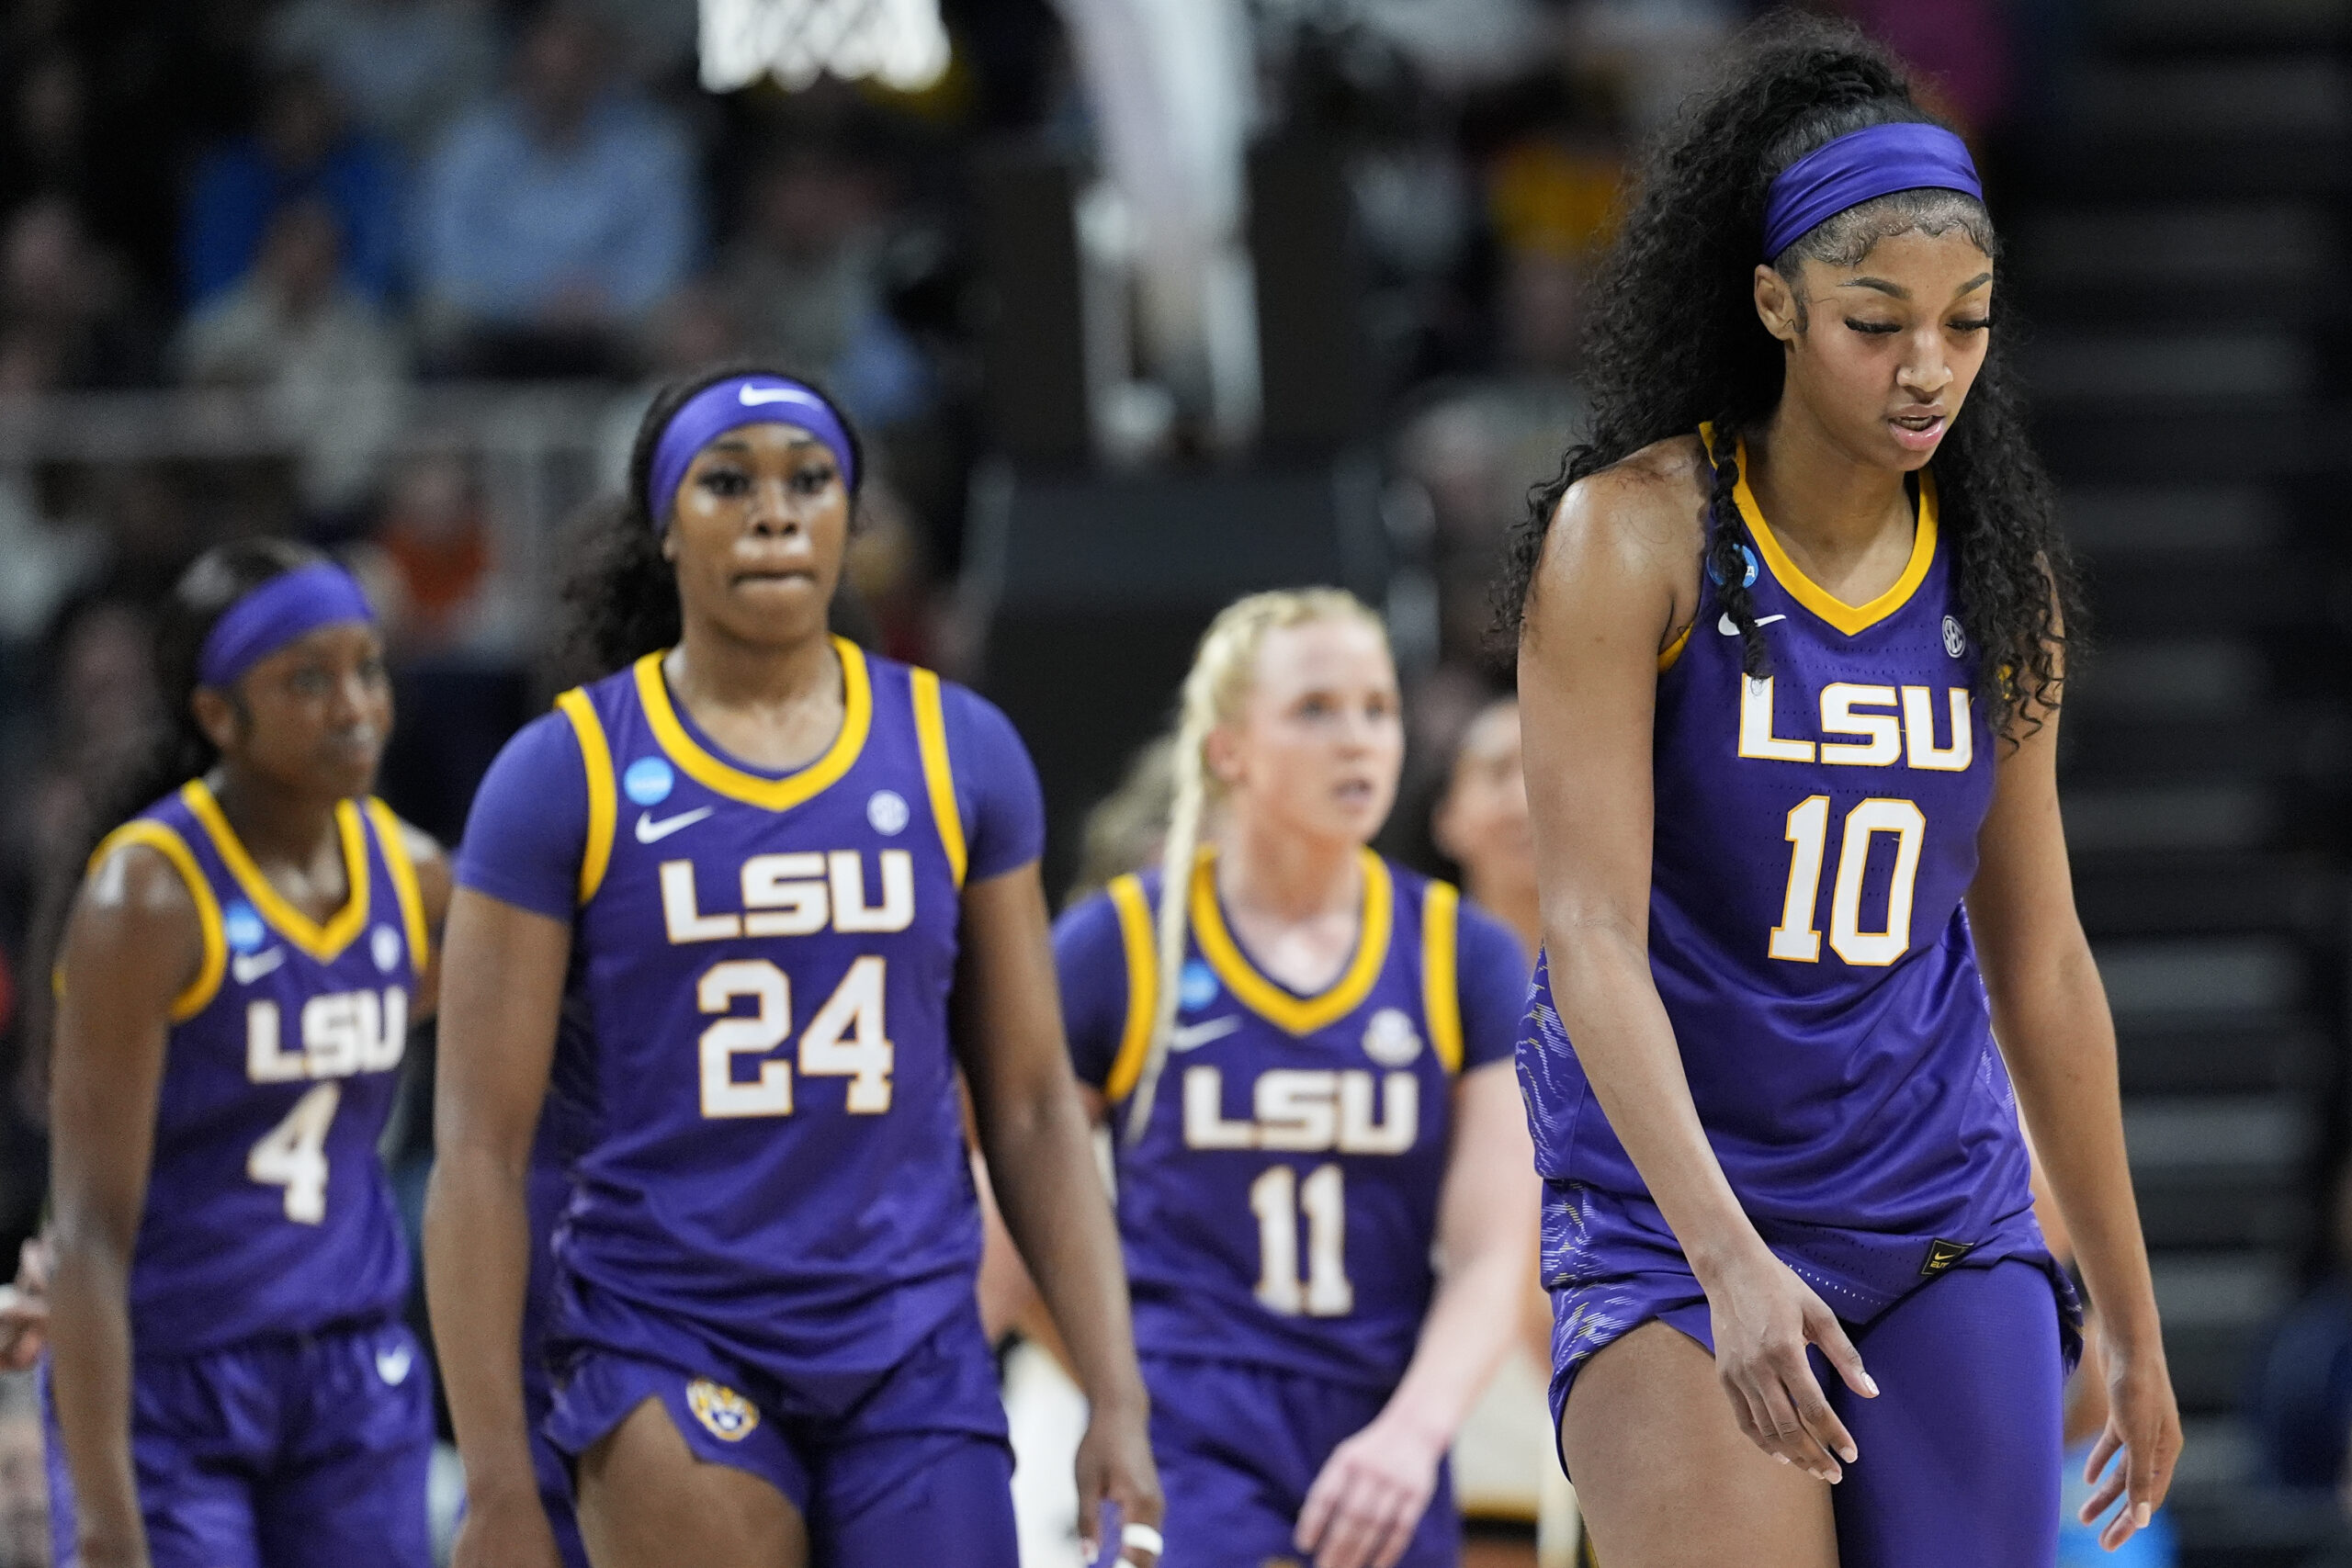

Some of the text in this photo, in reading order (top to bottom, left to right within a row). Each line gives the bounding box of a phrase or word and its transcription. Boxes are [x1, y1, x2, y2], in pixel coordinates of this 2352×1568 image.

[1738, 673, 1973, 772] LSU
[659, 849, 916, 945] LSU
[1768, 795, 1927, 966] 10
[246, 985, 408, 1085] LSU
[697, 954, 894, 1120] 24
[246, 1079, 342, 1225] 4
[1183, 1065, 1419, 1156] LSU
[1250, 1163, 1354, 1317] 11
